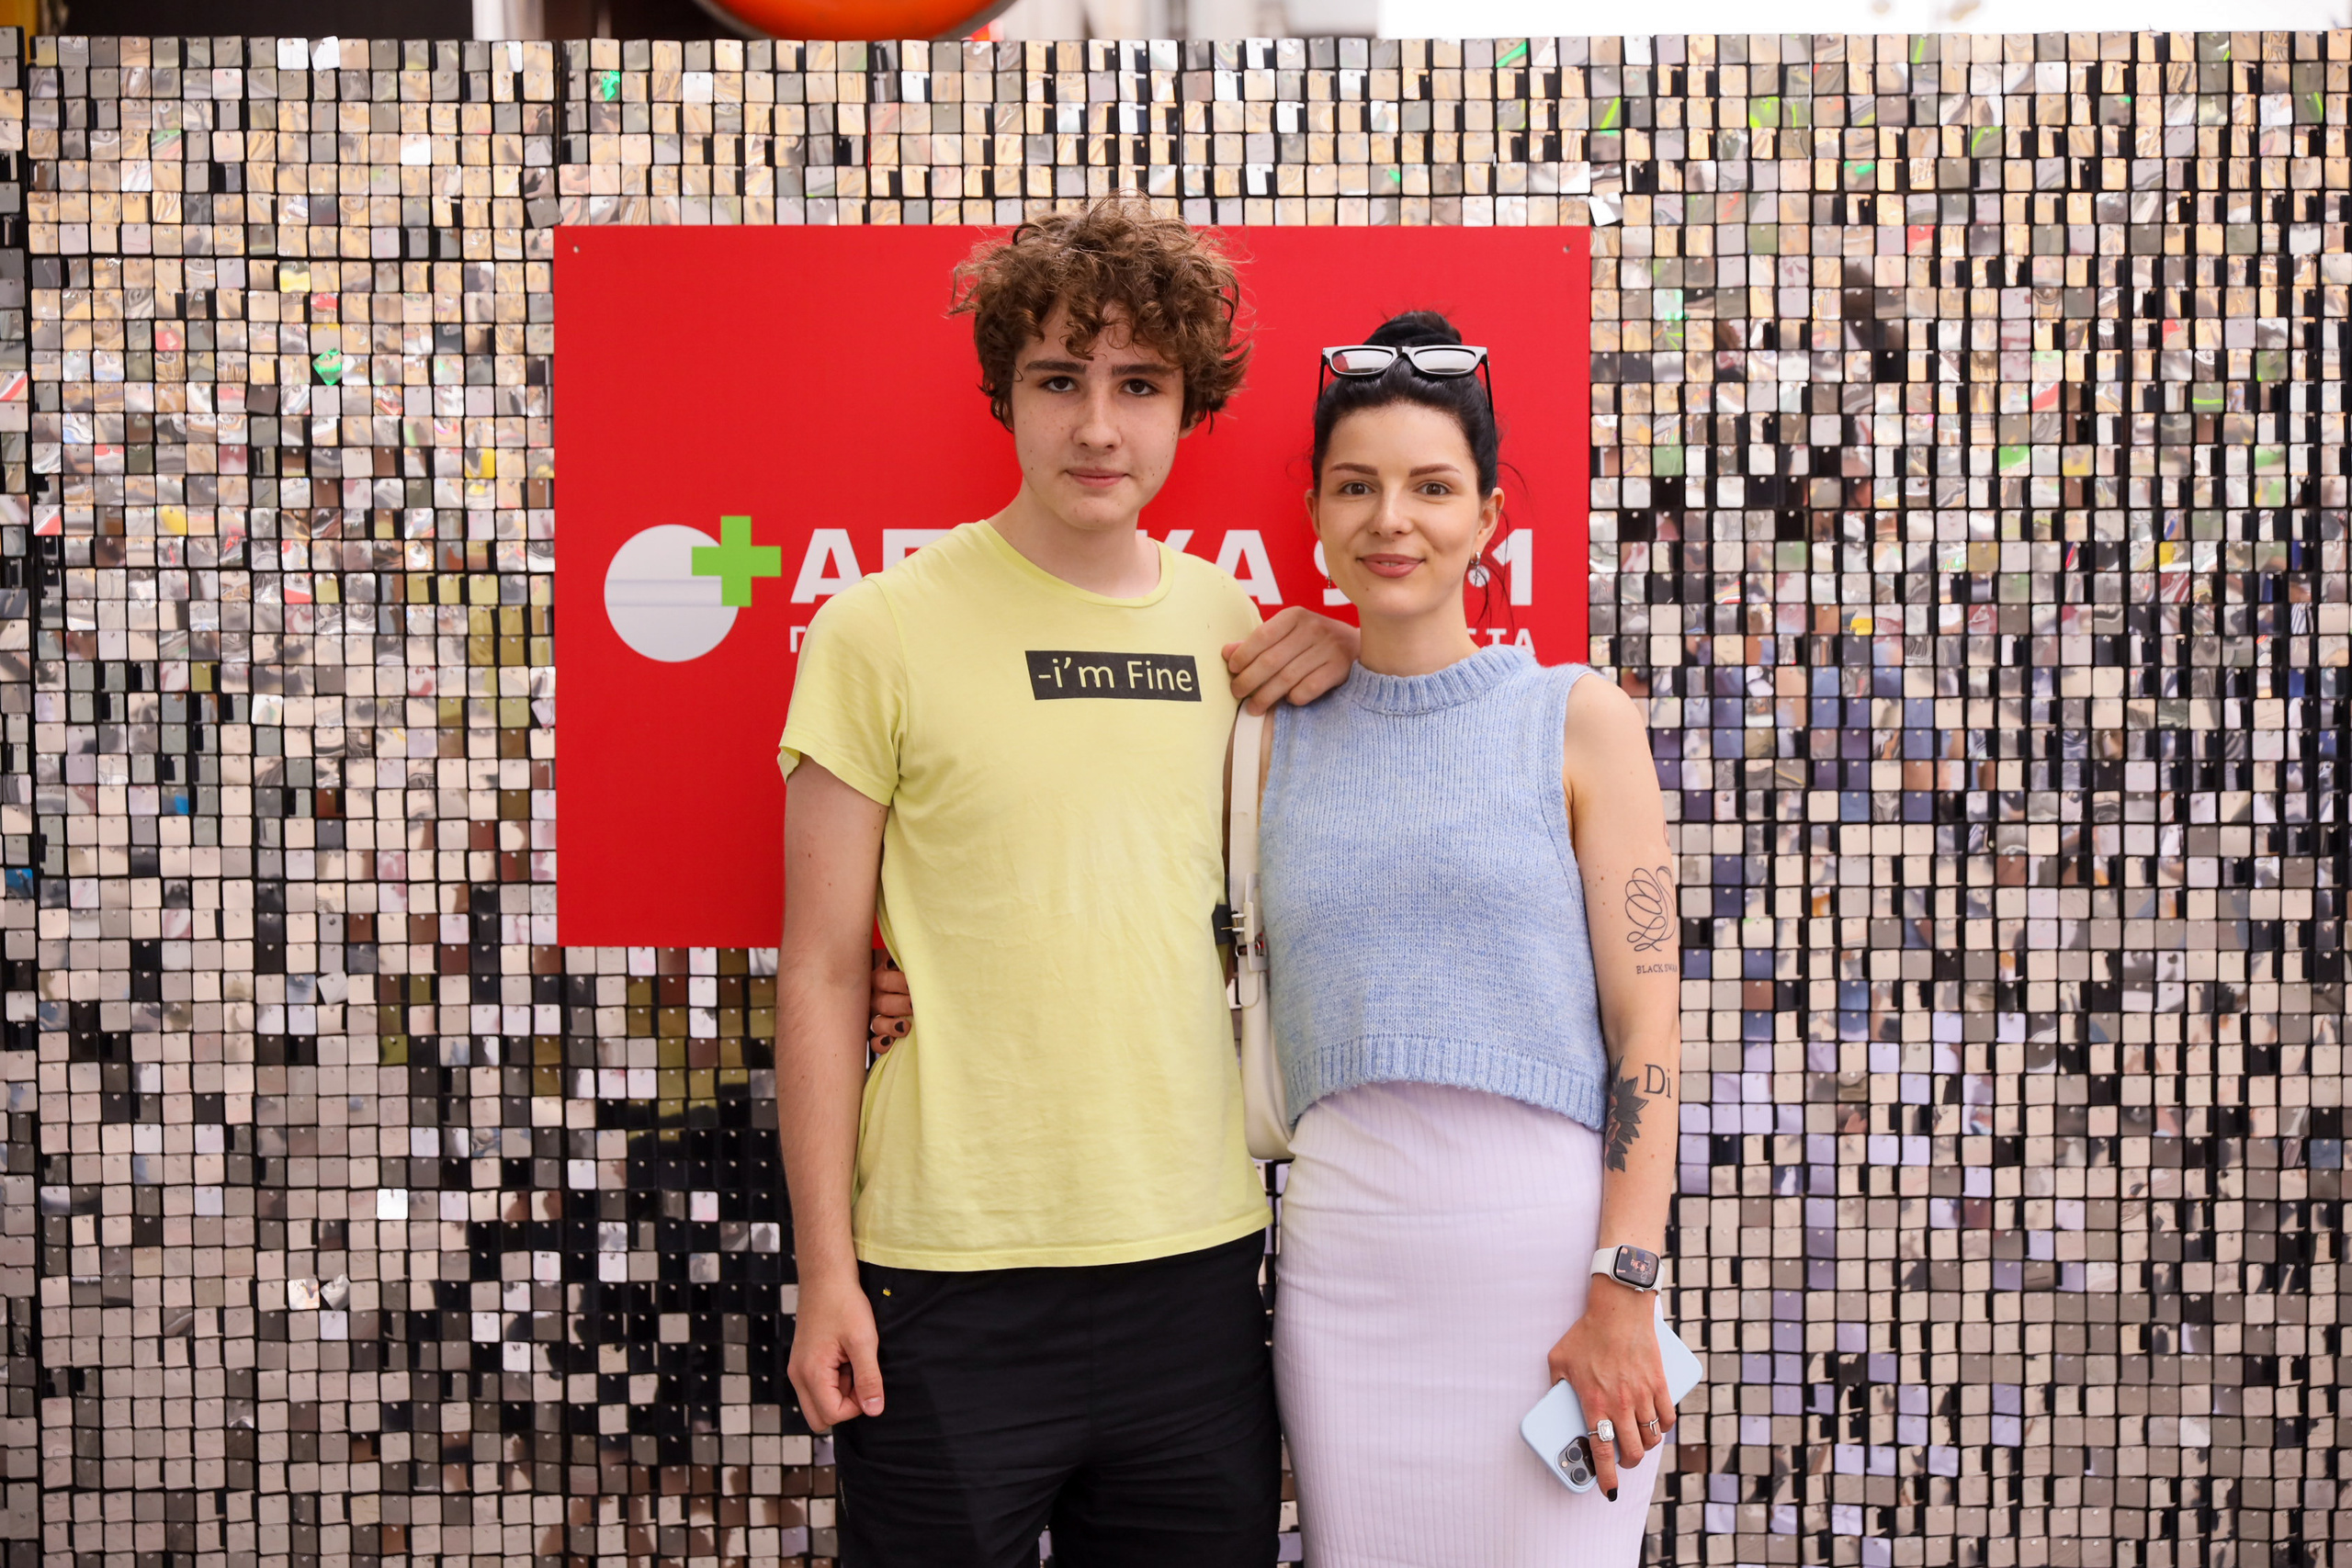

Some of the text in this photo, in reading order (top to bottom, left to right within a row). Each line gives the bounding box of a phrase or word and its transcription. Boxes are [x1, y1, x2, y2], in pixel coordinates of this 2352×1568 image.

[1126, 660, 1193, 692] Fine
[1636, 964, 1664, 975] BLACK
[1643, 1063, 1672, 1100] Di
